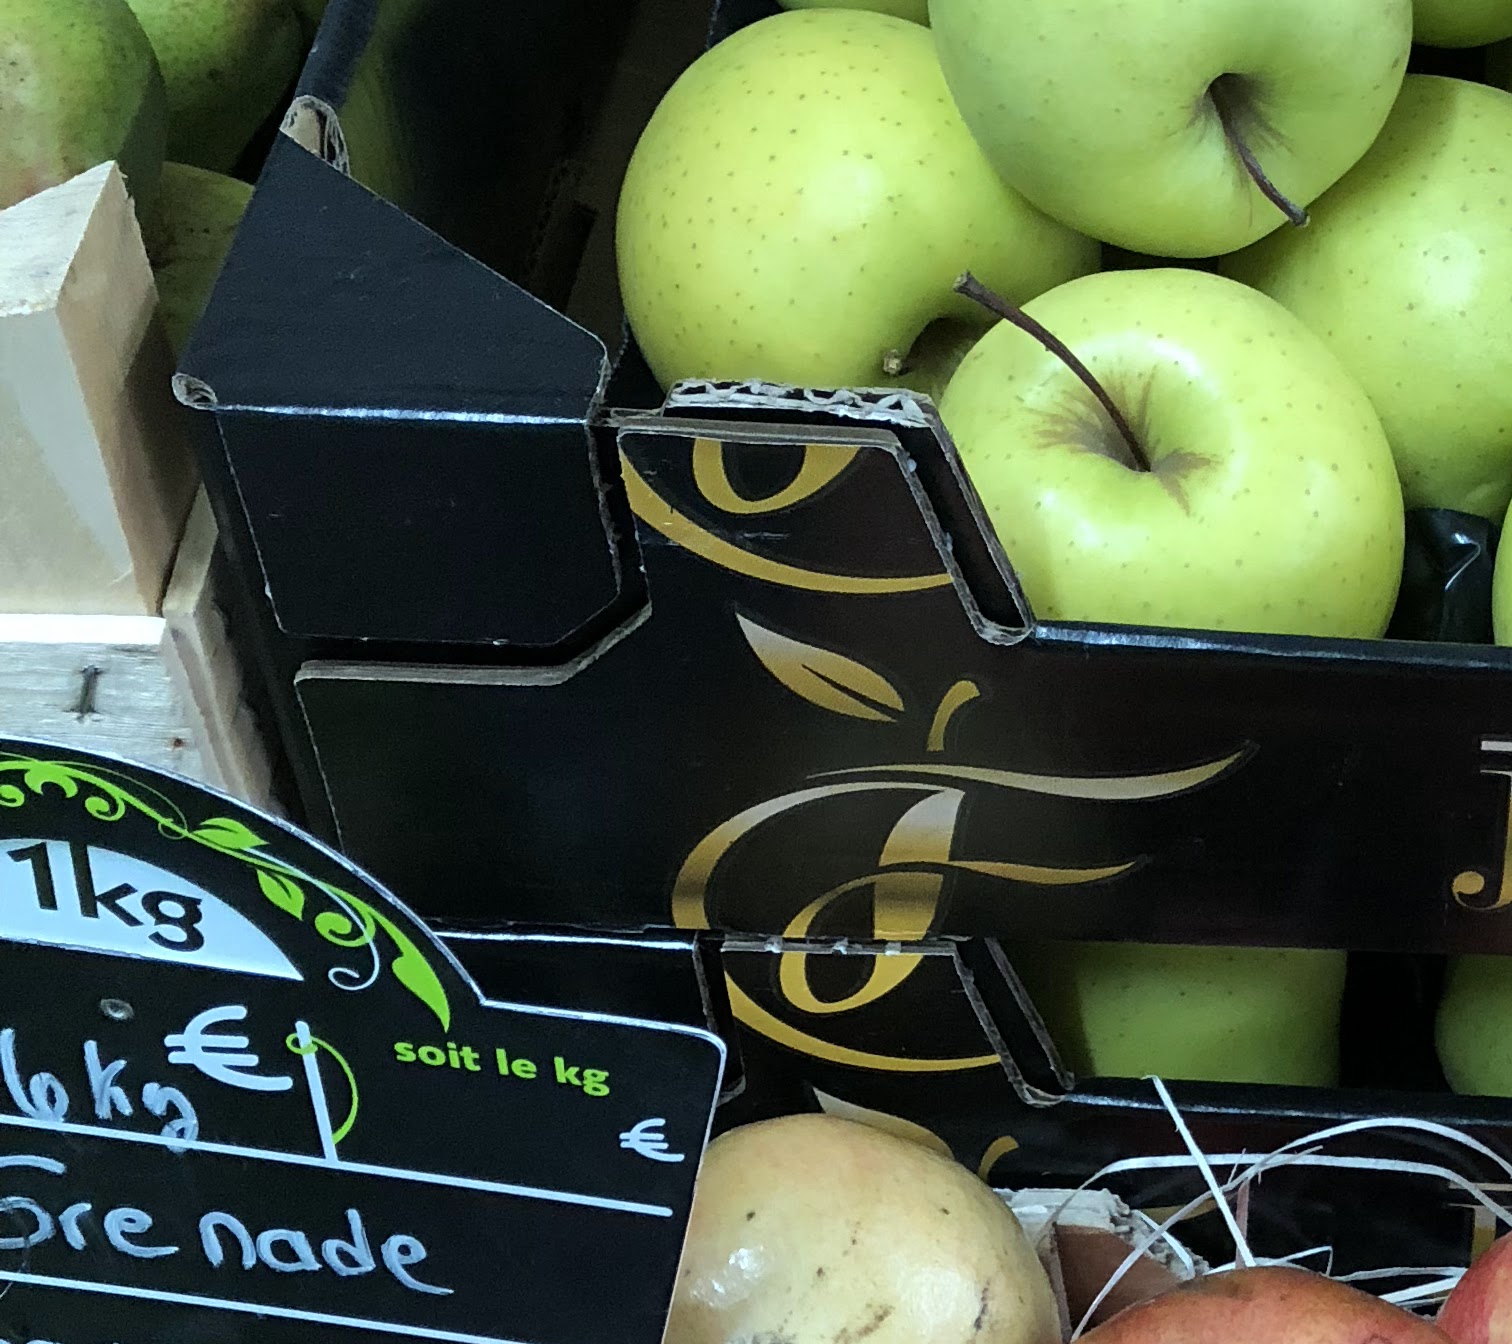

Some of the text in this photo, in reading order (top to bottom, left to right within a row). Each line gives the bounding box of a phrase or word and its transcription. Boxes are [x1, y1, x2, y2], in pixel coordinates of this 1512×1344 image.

[394, 1039, 611, 1097] soit le kg
